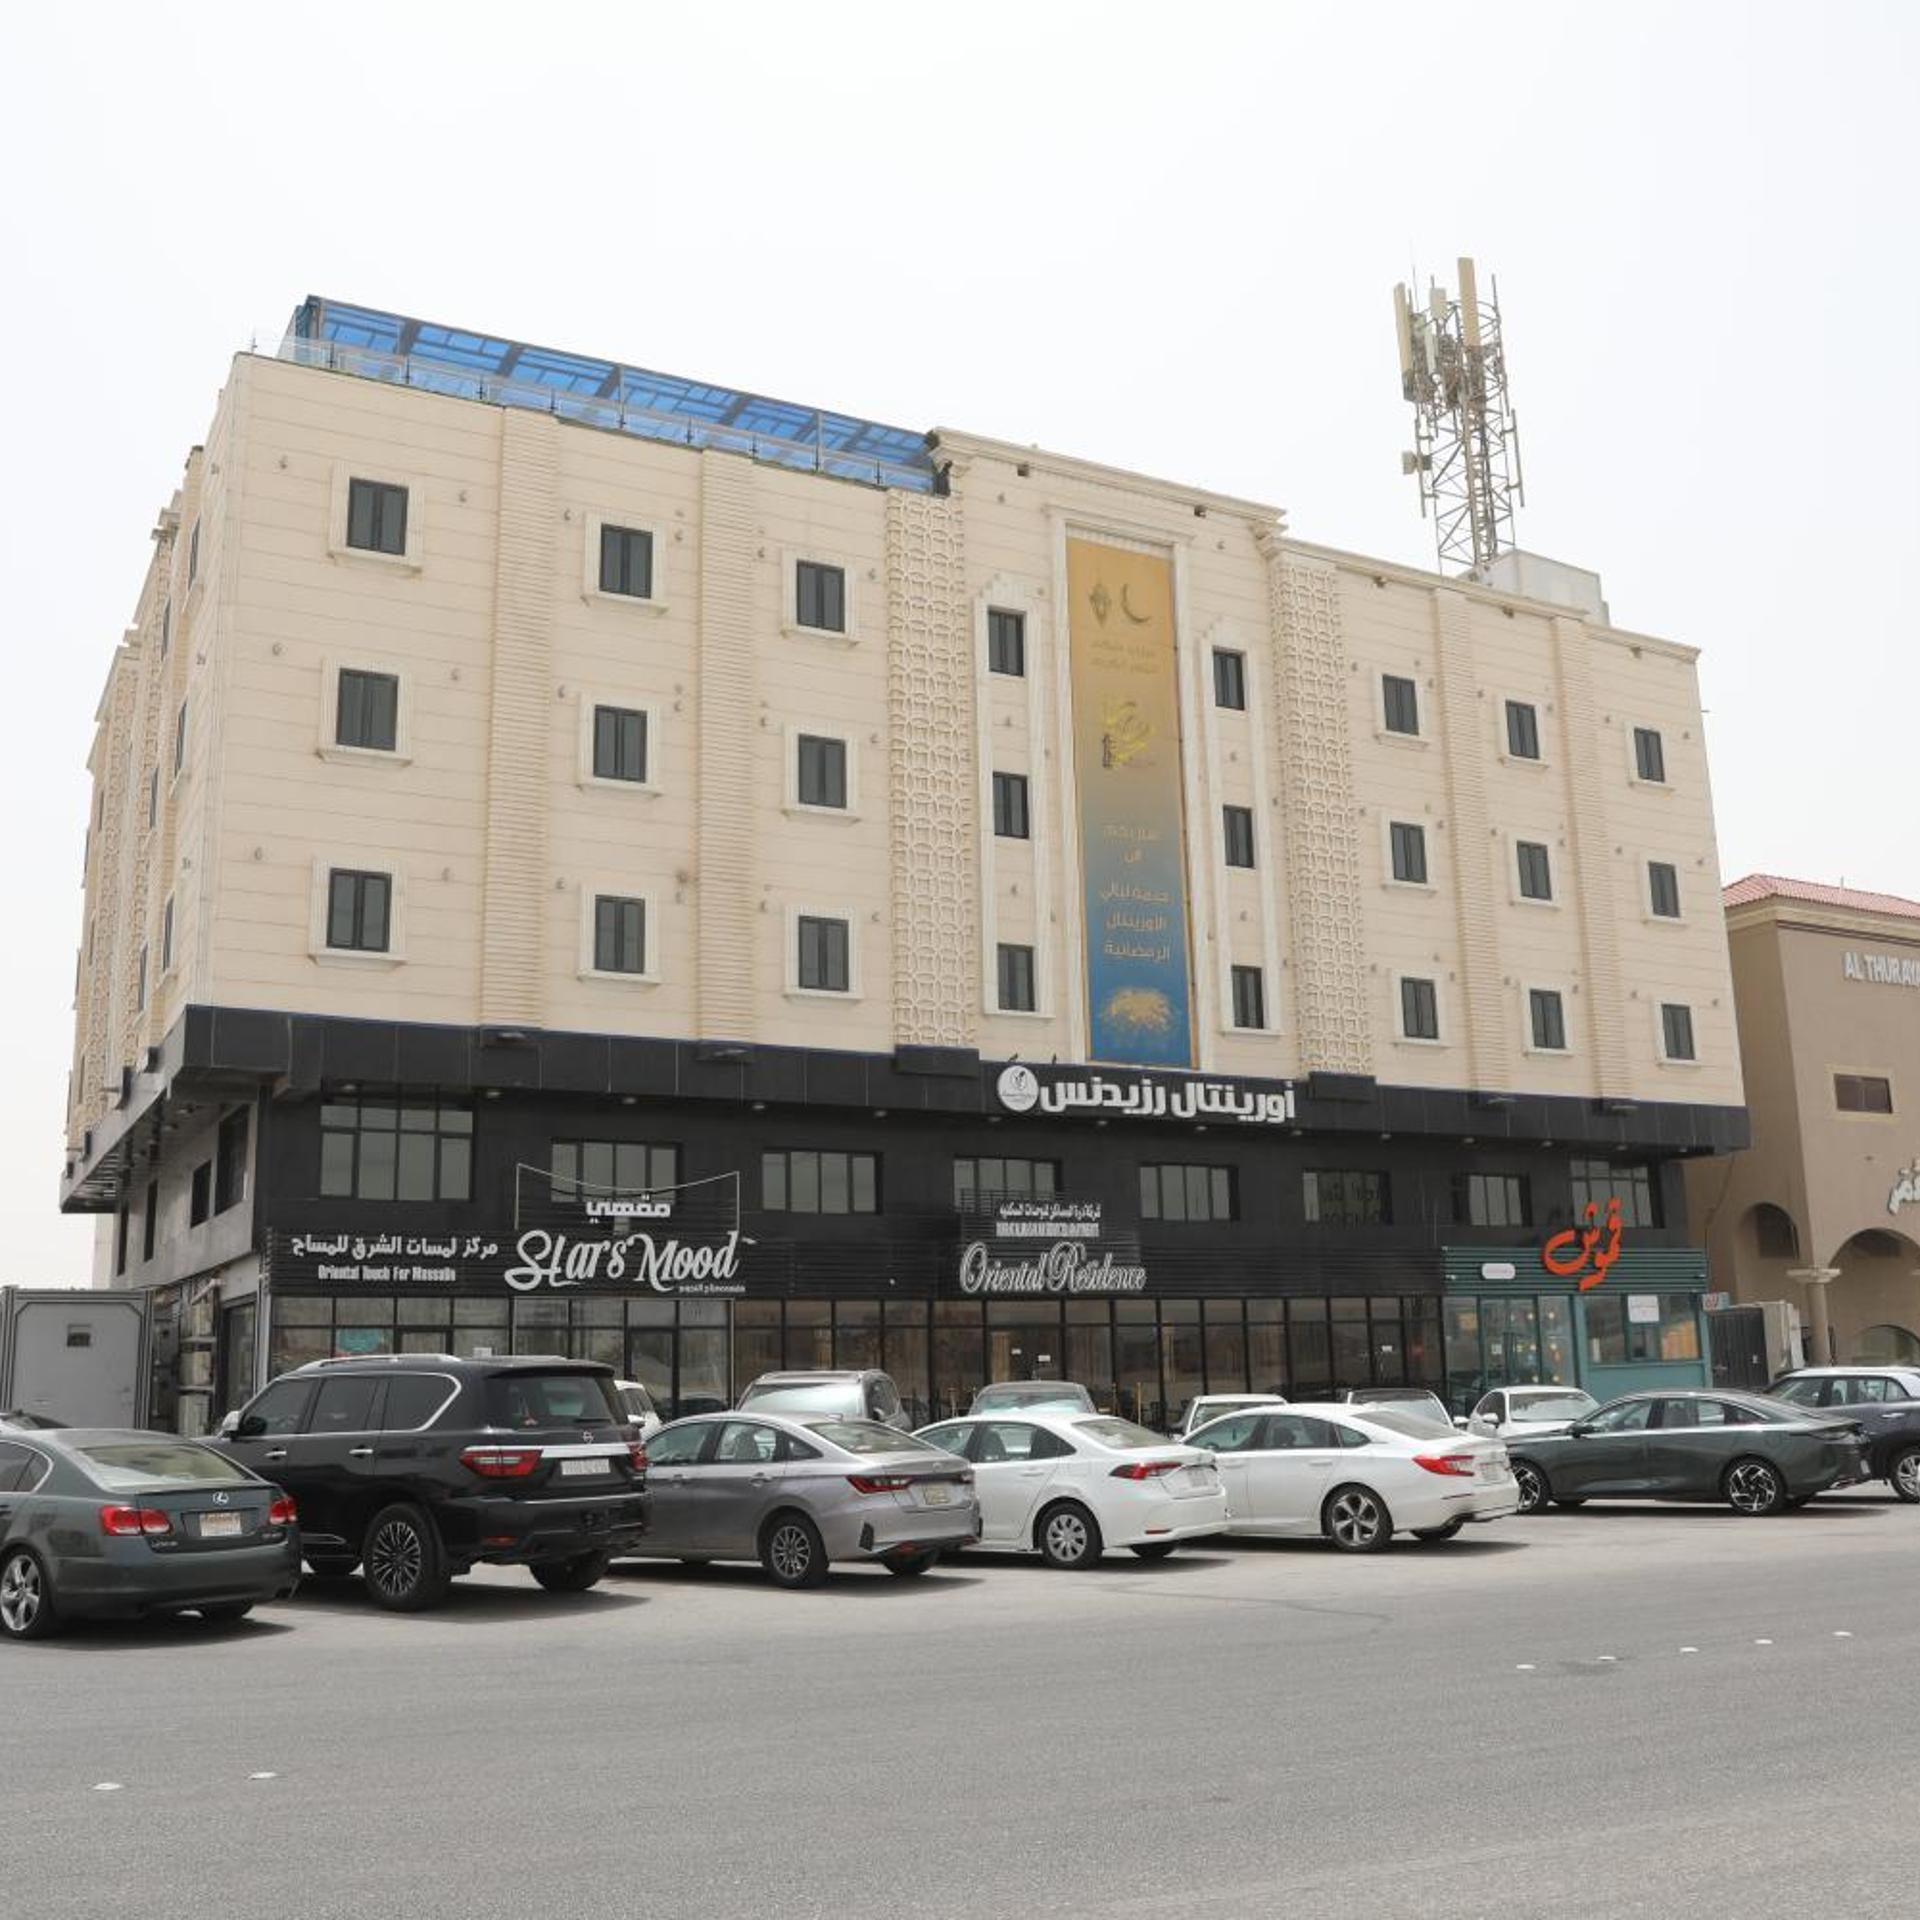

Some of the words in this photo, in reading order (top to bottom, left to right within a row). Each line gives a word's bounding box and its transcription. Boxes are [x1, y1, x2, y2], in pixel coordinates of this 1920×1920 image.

[1845, 951, 1864, 980] AL
[1039, 1076, 1166, 1115] رزيدنس
[1171, 1081, 1296, 1124] أورينتال
[291, 1234, 349, 1257] للمساج
[352, 1233, 402, 1260] الشرق
[406, 1236, 457, 1258] لمسات
[462, 1236, 499, 1259] مركز
[626, 1230, 740, 1293] Mood
[959, 1241, 1050, 1293] Oriental
[1049, 1241, 1147, 1294] Residence
